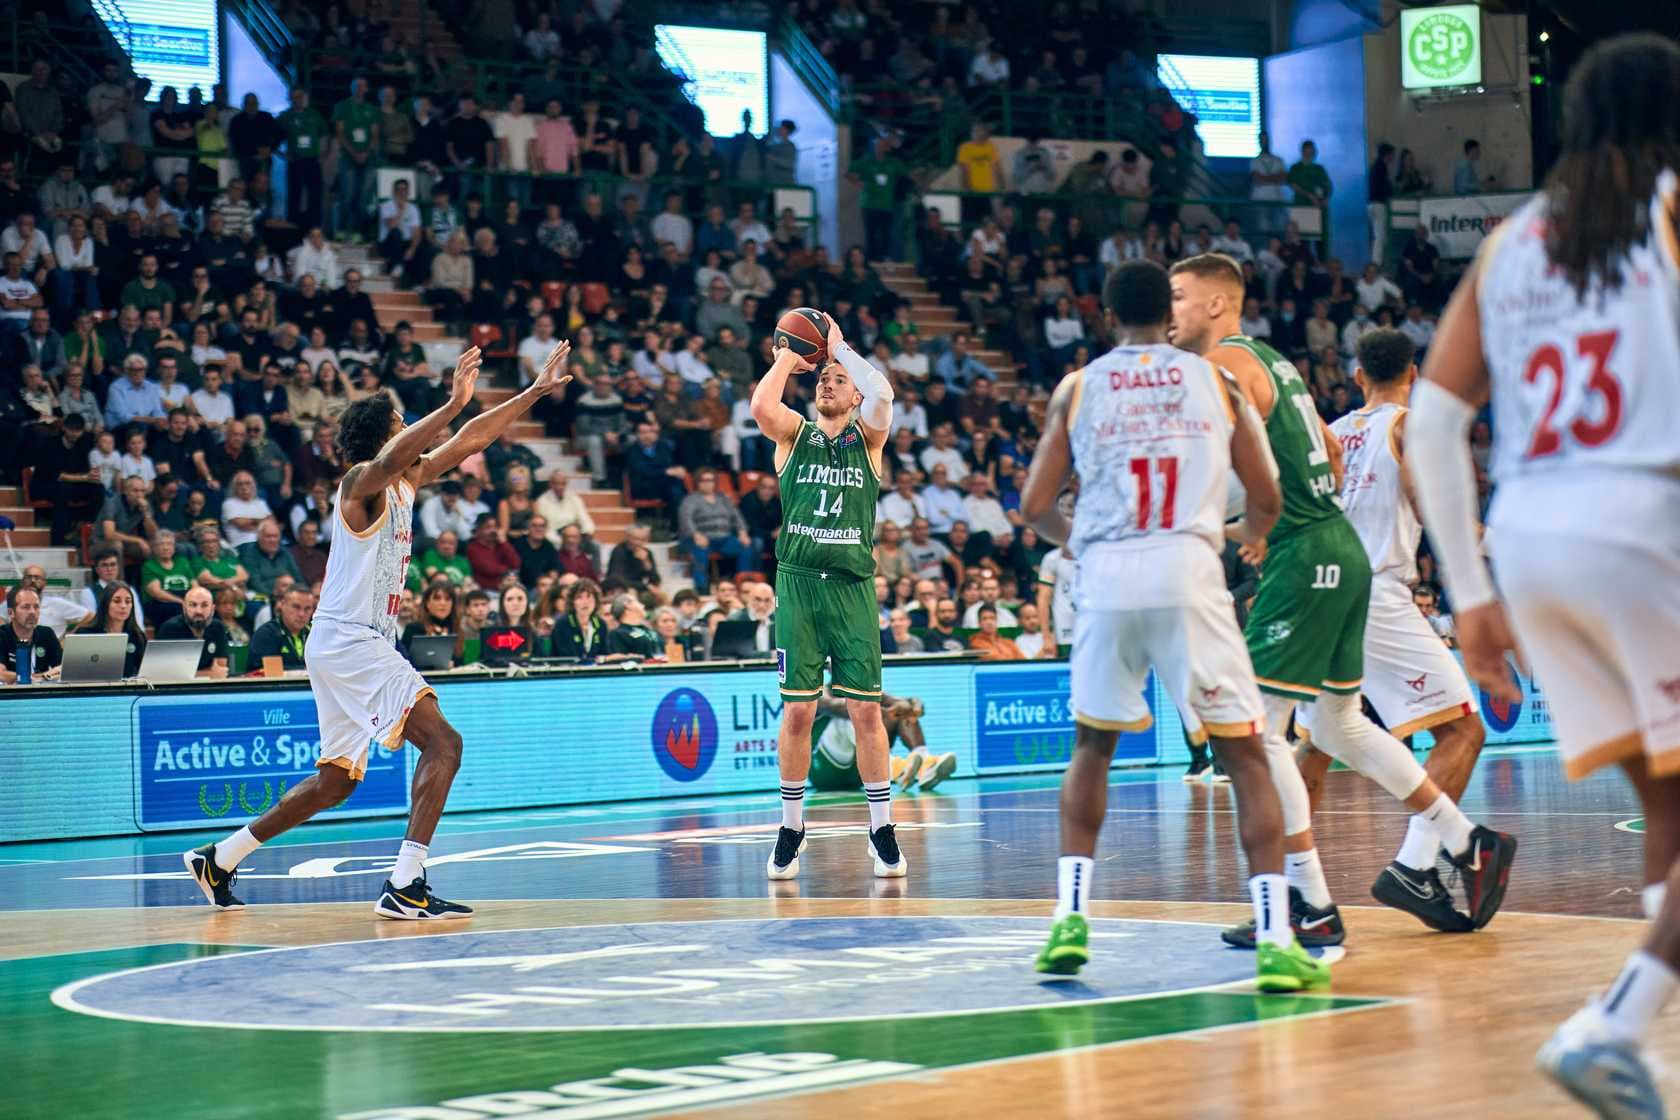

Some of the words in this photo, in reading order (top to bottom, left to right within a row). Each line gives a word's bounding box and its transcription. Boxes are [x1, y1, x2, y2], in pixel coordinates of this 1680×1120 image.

[1414, 25, 1468, 60] CSP
[1110, 367, 1183, 390] DIALLO
[1524, 329, 1624, 458] 23
[813, 489, 843, 517] 14
[1130, 457, 1178, 530] 11
[1311, 564, 1341, 589] 10
[263, 708, 291, 725] Ville
[985, 700, 1047, 726] Active
[1050, 698, 1063, 722] &
[154, 737, 246, 771] Active
[251, 735, 276, 766] &
